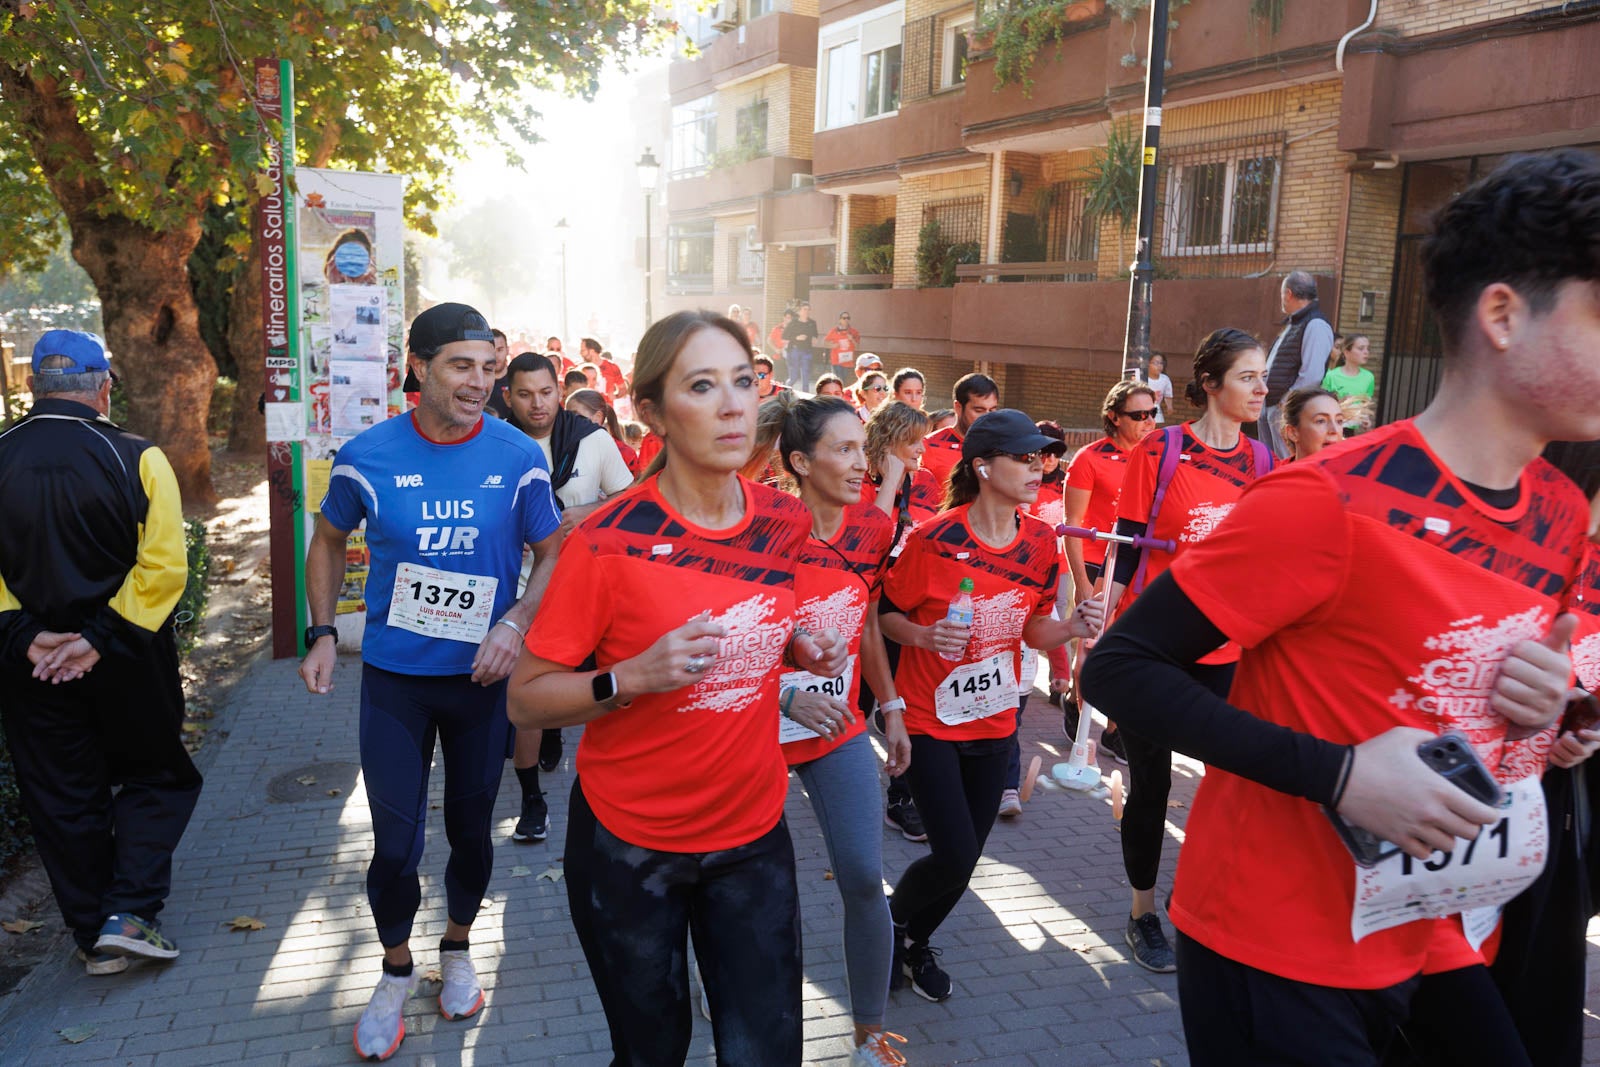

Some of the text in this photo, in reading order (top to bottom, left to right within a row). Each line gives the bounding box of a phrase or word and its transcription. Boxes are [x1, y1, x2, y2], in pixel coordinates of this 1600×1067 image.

[268, 359, 296, 367] MPS
[422, 499, 475, 521] LUIS
[415, 526, 480, 551] TJR
[410, 581, 475, 610] 1379
[419, 605, 463, 620] LUIS ROLDAN
[972, 610, 1027, 627] arrera
[720, 627, 786, 659] rrera
[949, 668, 1002, 698] 1451
[974, 695, 987, 703] ANA
